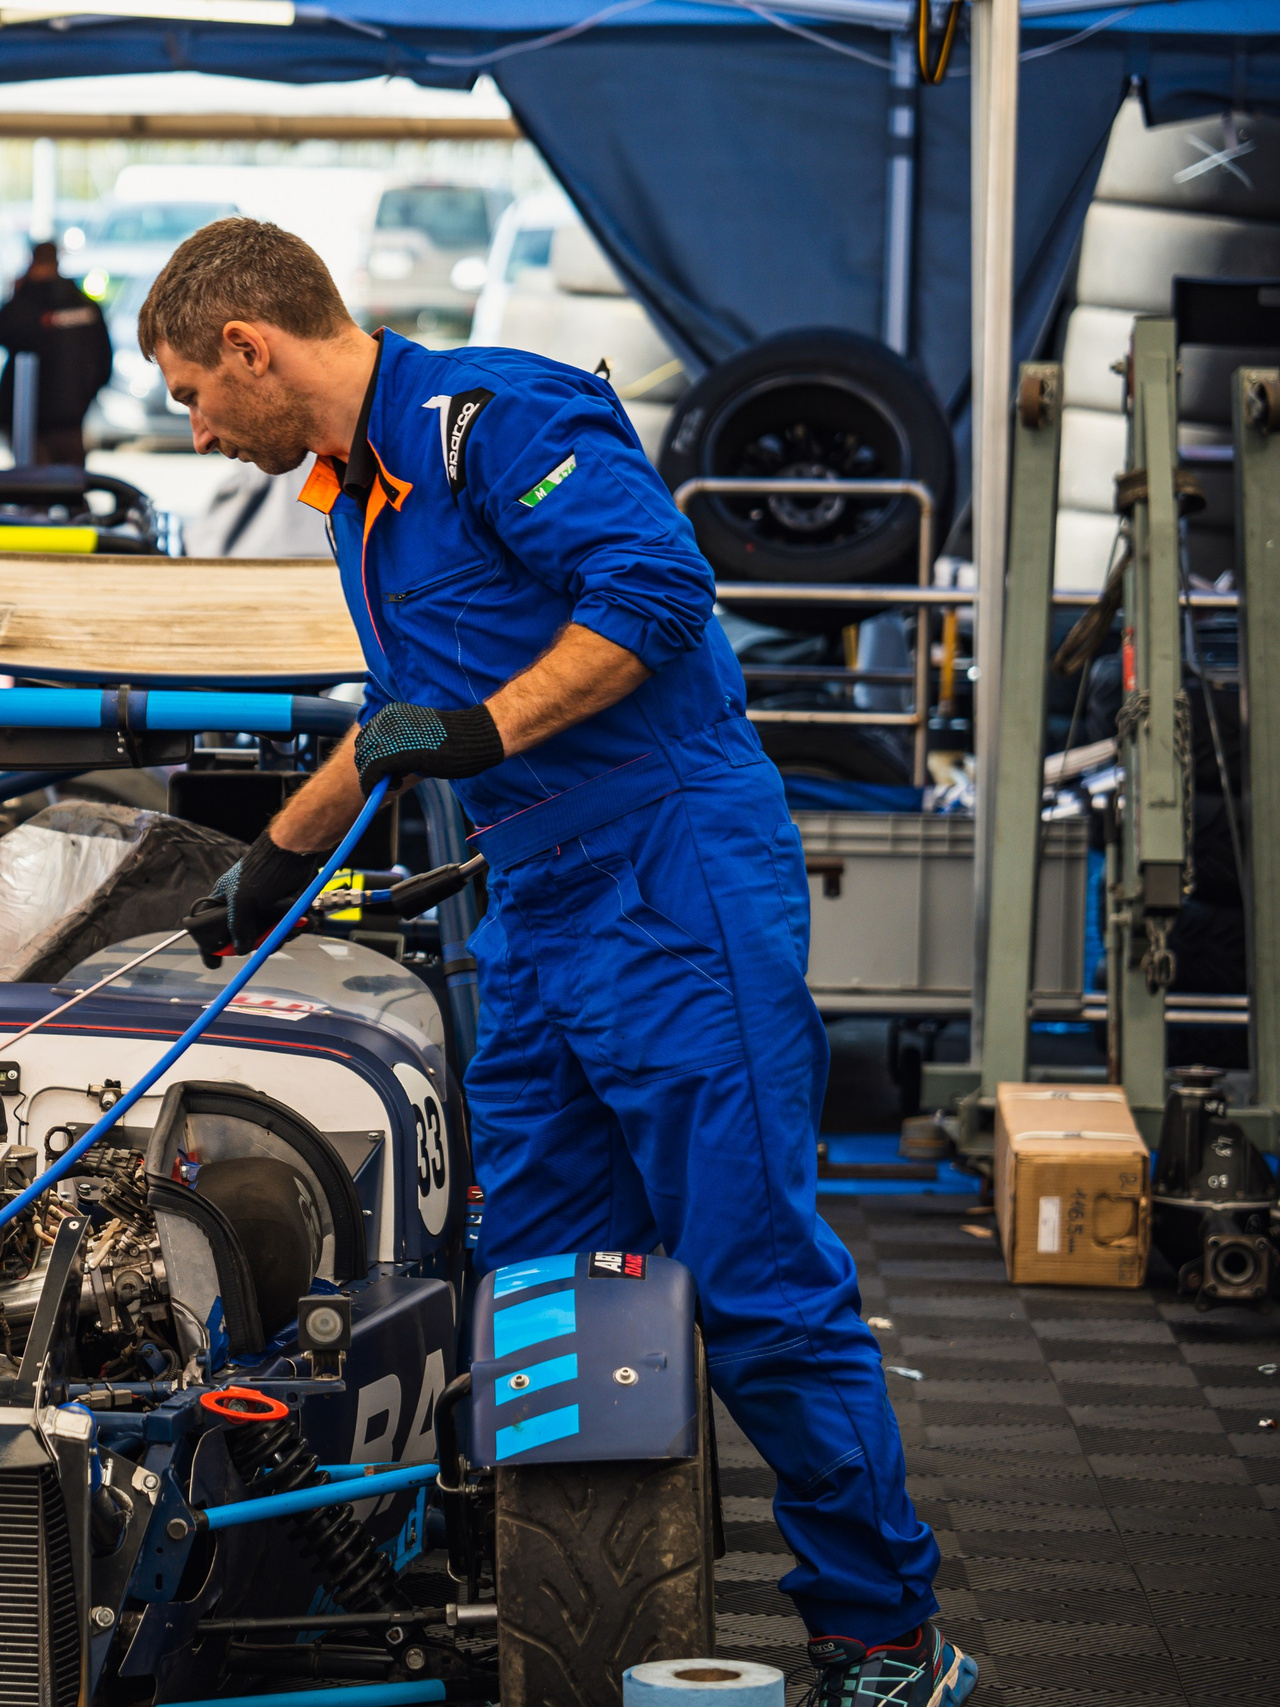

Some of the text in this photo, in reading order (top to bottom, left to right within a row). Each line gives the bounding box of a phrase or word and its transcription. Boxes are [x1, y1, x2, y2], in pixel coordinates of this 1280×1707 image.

[534, 486, 548, 501] M
[411, 1096, 446, 1198] 33
[593, 1251, 623, 1273] АВТ
